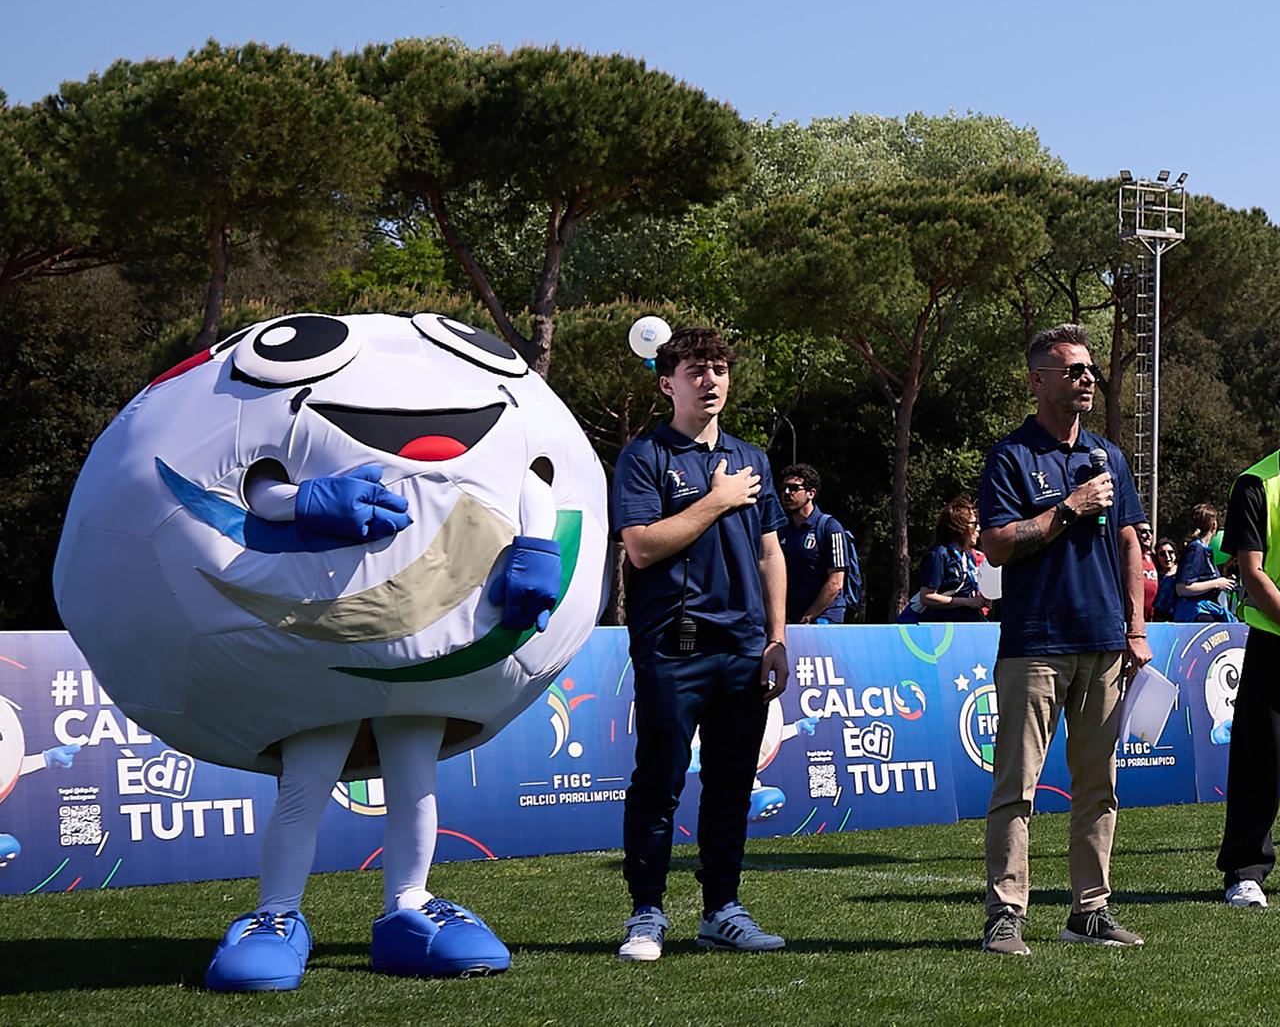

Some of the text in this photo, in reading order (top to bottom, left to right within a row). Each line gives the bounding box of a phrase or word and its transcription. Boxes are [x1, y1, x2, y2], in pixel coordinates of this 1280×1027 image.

[796, 656, 845, 686] #IL
[53, 709, 160, 747] CAL
[1123, 742, 1151, 755] FIGC
[1127, 755, 1176, 767] PARALIMPICO
[553, 773, 592, 789] FIGC
[847, 761, 937, 794] TUTTI
[519, 789, 626, 806] CALCIO PARALIMPICO
[119, 798, 255, 841] TUTTI
